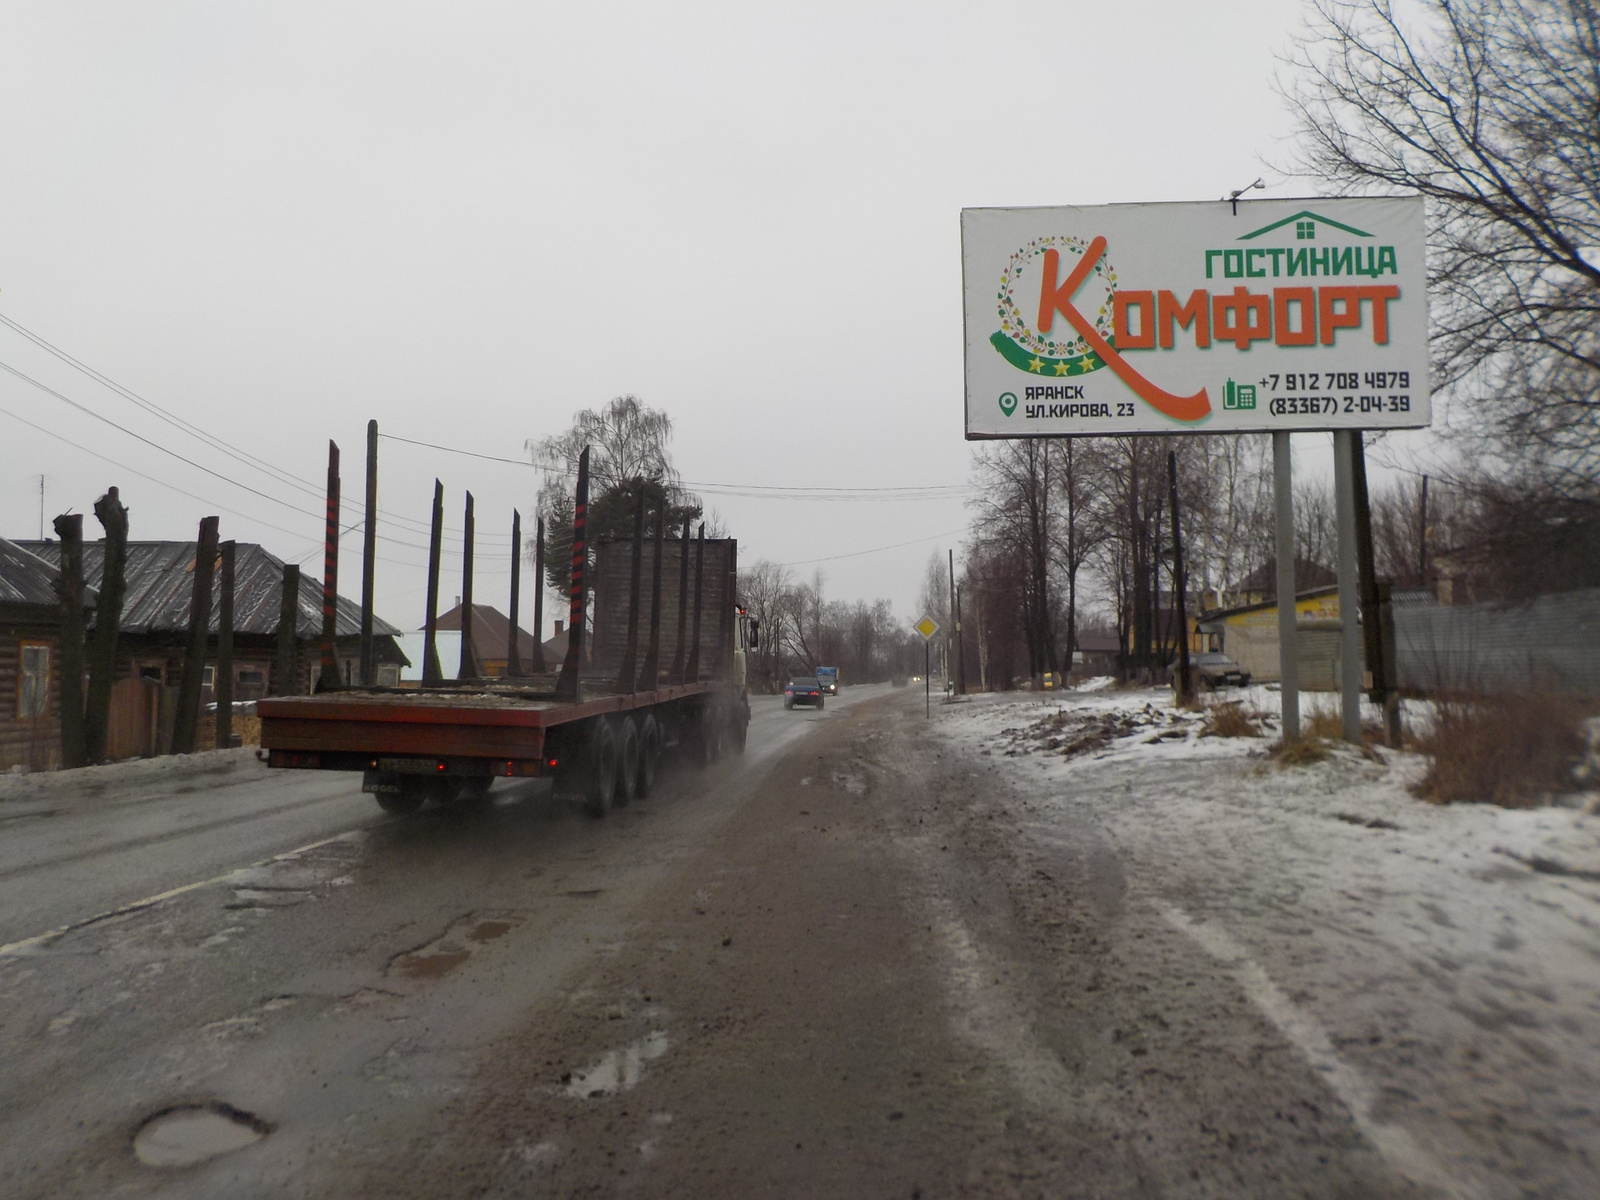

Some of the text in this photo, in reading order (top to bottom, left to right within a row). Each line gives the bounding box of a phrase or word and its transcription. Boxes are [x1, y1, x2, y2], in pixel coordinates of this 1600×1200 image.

[1205, 245, 1398, 278] ГОСТИНИЦА
[1036, 235, 1400, 422] КОМФОРТ
[1259, 371, 1410, 391] +7 912 708 4979
[1025, 385, 1084, 400] ЯРАНСК
[1116, 402, 1135, 416] 23
[1269, 395, 1410, 416] (83367) 2-04-39
